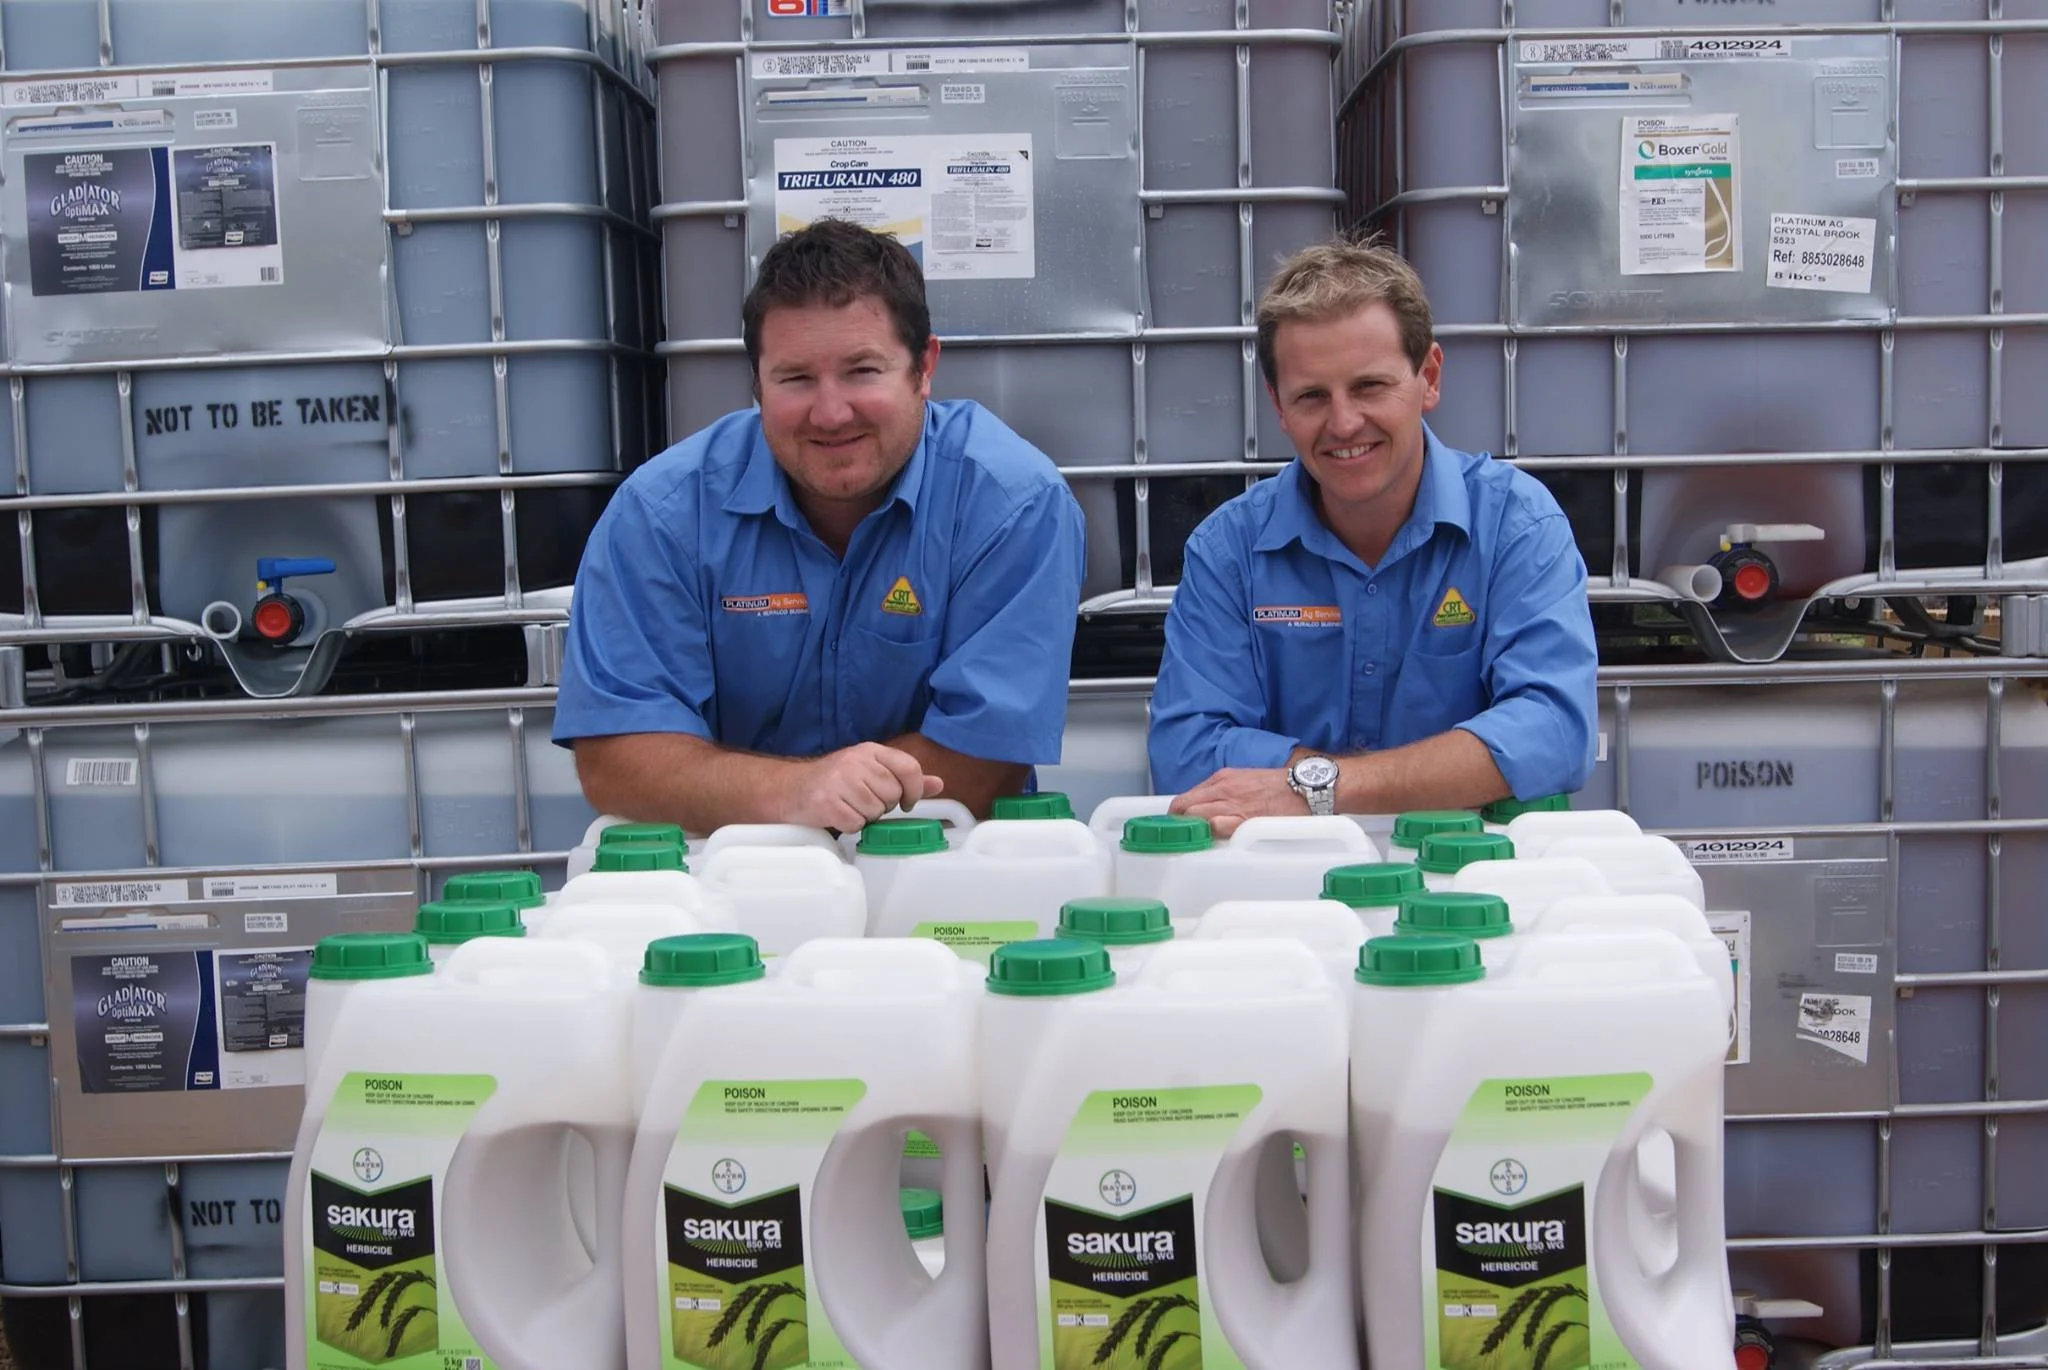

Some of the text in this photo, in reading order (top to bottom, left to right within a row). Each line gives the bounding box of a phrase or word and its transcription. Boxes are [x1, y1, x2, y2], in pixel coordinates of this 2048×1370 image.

[1690, 40, 1782, 50] 4012924
[830, 140, 867, 148] CAUTION
[1658, 143, 1728, 156] Boxer Gold
[65, 154, 103, 165] CAUTION
[830, 160, 868, 169] Crop Care
[1684, 168, 1712, 176] syngenta
[783, 172, 918, 188] TRIFLURALIN 480
[50, 181, 121, 216] GLADIATOR
[65, 204, 109, 218] OptiMAX
[1774, 216, 1844, 228] PLATINUM AG
[1774, 226, 1860, 239] CRYSTAL BROOK
[1774, 250, 1864, 268] Ref: 8853028648
[145, 395, 380, 435] NOT TO BE TAKEN
[893, 590, 910, 602] CRT
[726, 600, 767, 608] PLATINUM
[1443, 600, 1462, 613] CRT
[1258, 610, 1298, 618] PLATINUM
[1694, 840, 1784, 852] 4012924
[934, 926, 965, 936] POISON
[112, 956, 149, 967] CAUTION
[98, 983, 166, 1016] GLADIATOR
[112, 1004, 155, 1019] OptiMAX
[365, 1079, 402, 1090] POISON
[724, 1088, 766, 1099] POISON
[1505, 1084, 1550, 1097] POISON
[1113, 1096, 1158, 1108] POISON
[190, 1198, 280, 1226] NOT TO
[327, 1204, 414, 1228] sakura
[400, 1228, 415, 1237] WG
[683, 1218, 780, 1240] sakura
[1456, 1220, 1564, 1244] sakura
[765, 1240, 782, 1248] WG
[1067, 1230, 1173, 1254] sakura
[1546, 1241, 1564, 1250] WG
[346, 1244, 392, 1255] HERBICIDE
[1156, 1252, 1174, 1260] WG
[706, 1258, 758, 1268] HERBICIDE
[1481, 1261, 1539, 1272] HERBICIDE
[1092, 1272, 1149, 1282] HERBICIDE
[444, 1357, 462, 1368] 5 kg
